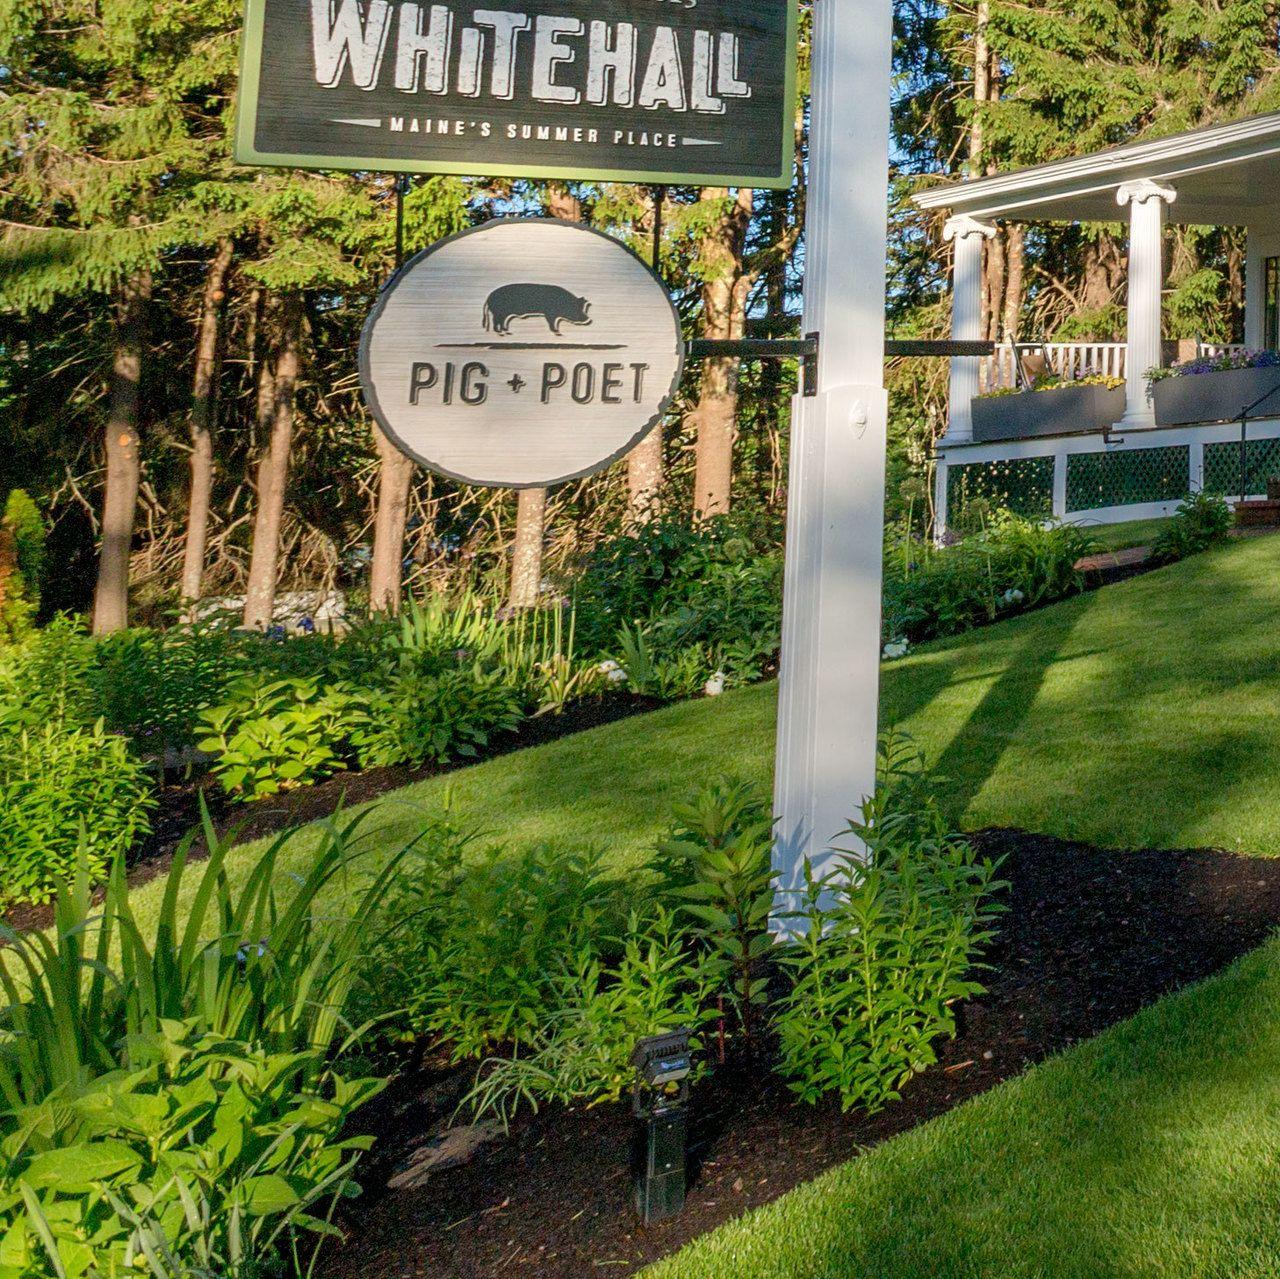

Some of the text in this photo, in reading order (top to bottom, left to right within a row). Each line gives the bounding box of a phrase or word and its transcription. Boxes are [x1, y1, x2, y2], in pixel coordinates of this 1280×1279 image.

[390, 117, 677, 147] MAINE'S SUMMER PLACE
[408, 362, 489, 405] PIG
[540, 362, 650, 404] POET
